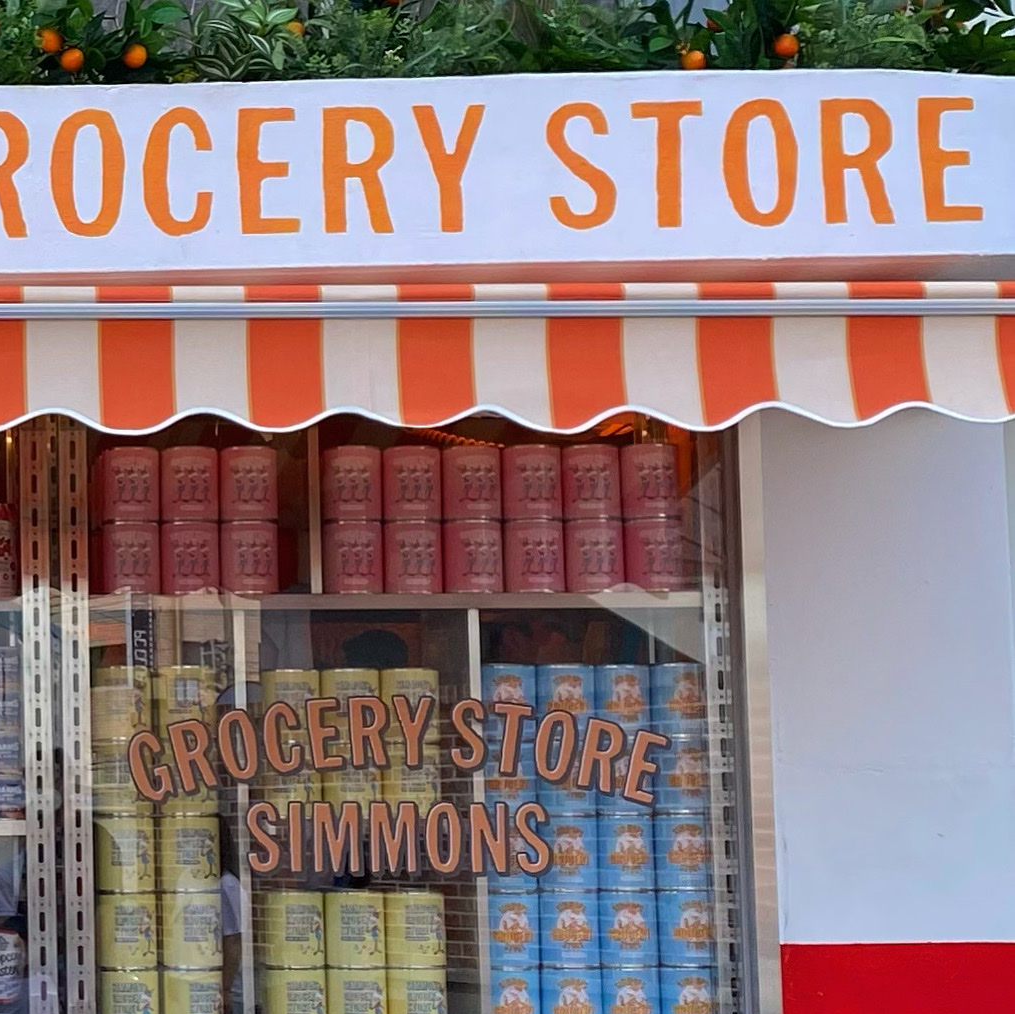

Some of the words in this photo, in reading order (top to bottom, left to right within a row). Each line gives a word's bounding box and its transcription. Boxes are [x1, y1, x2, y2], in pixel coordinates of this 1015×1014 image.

[546, 97, 982, 230] STORE
[129, 696, 432, 800] GROCERY
[451, 701, 669, 803] STORE
[248, 803, 550, 873] SIMMONS
